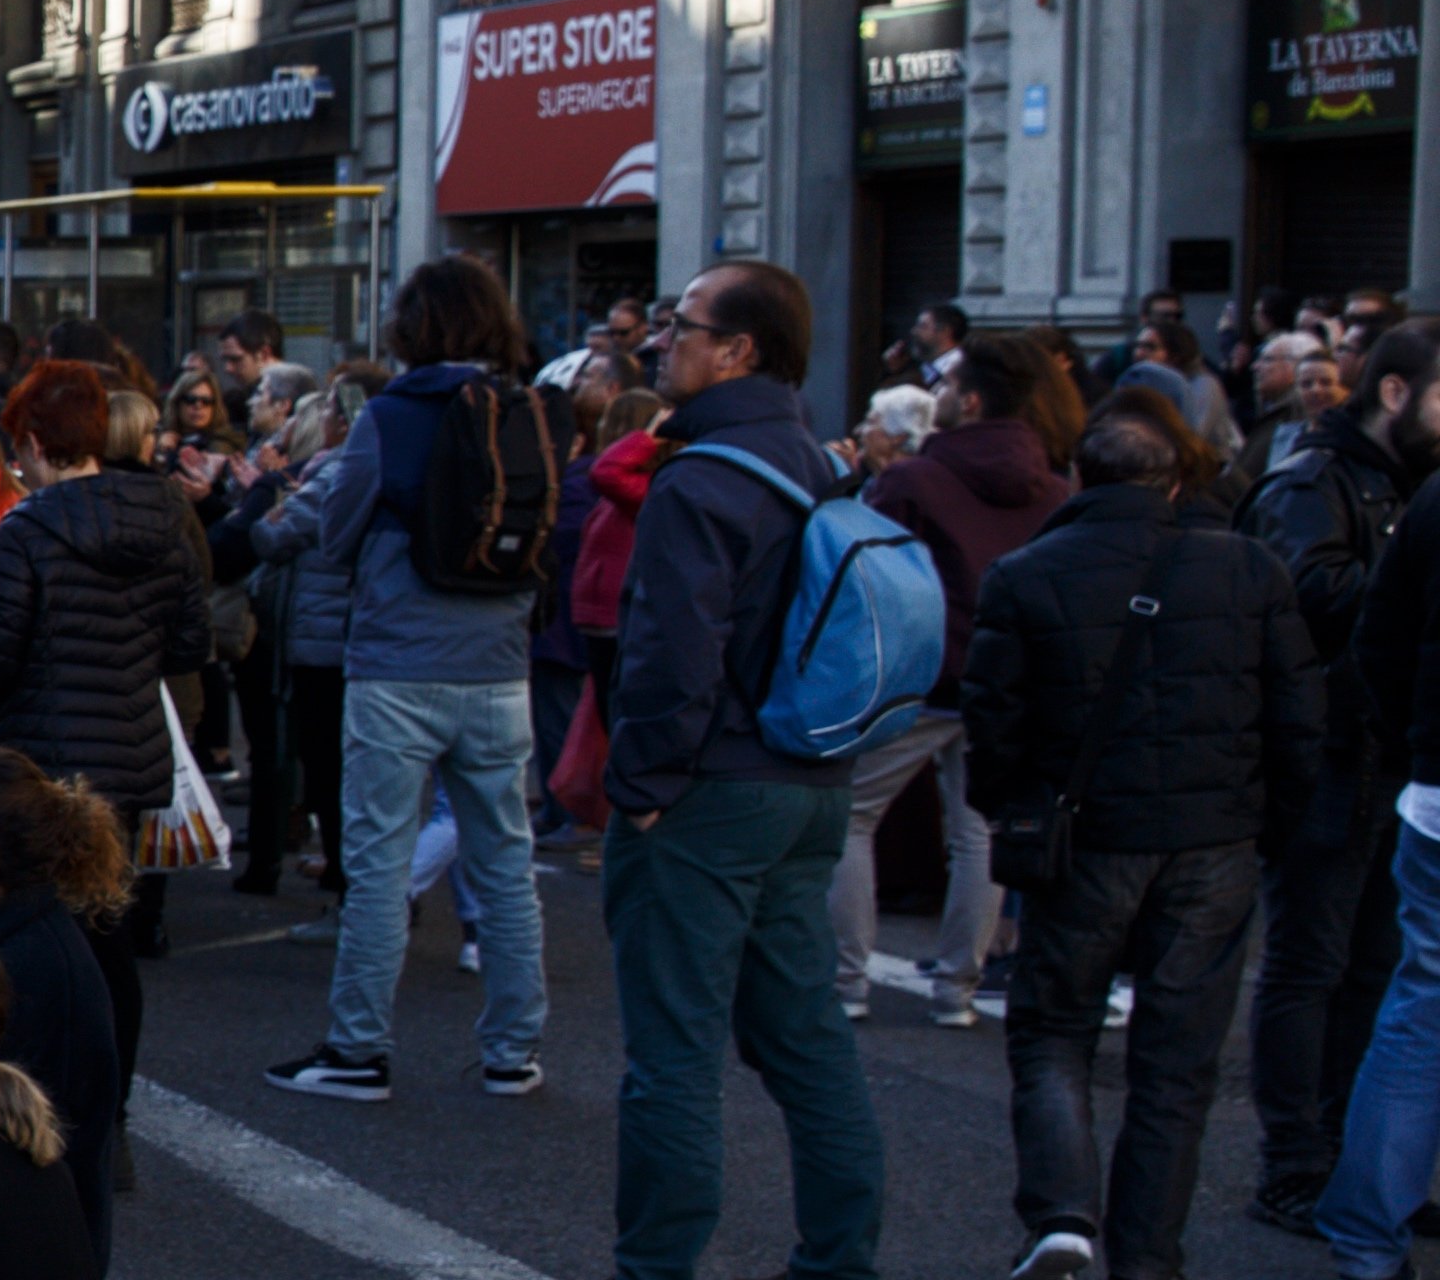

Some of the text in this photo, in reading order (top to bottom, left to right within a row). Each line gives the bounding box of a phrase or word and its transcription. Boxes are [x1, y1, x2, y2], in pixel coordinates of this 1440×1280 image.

[473, 6, 654, 80] SUPER STORE
[1268, 24, 1421, 72] LA TAVERNA
[868, 56, 895, 86] LA
[170, 77, 316, 135] casanovafoto
[537, 75, 652, 119] SUPERMERCAT
